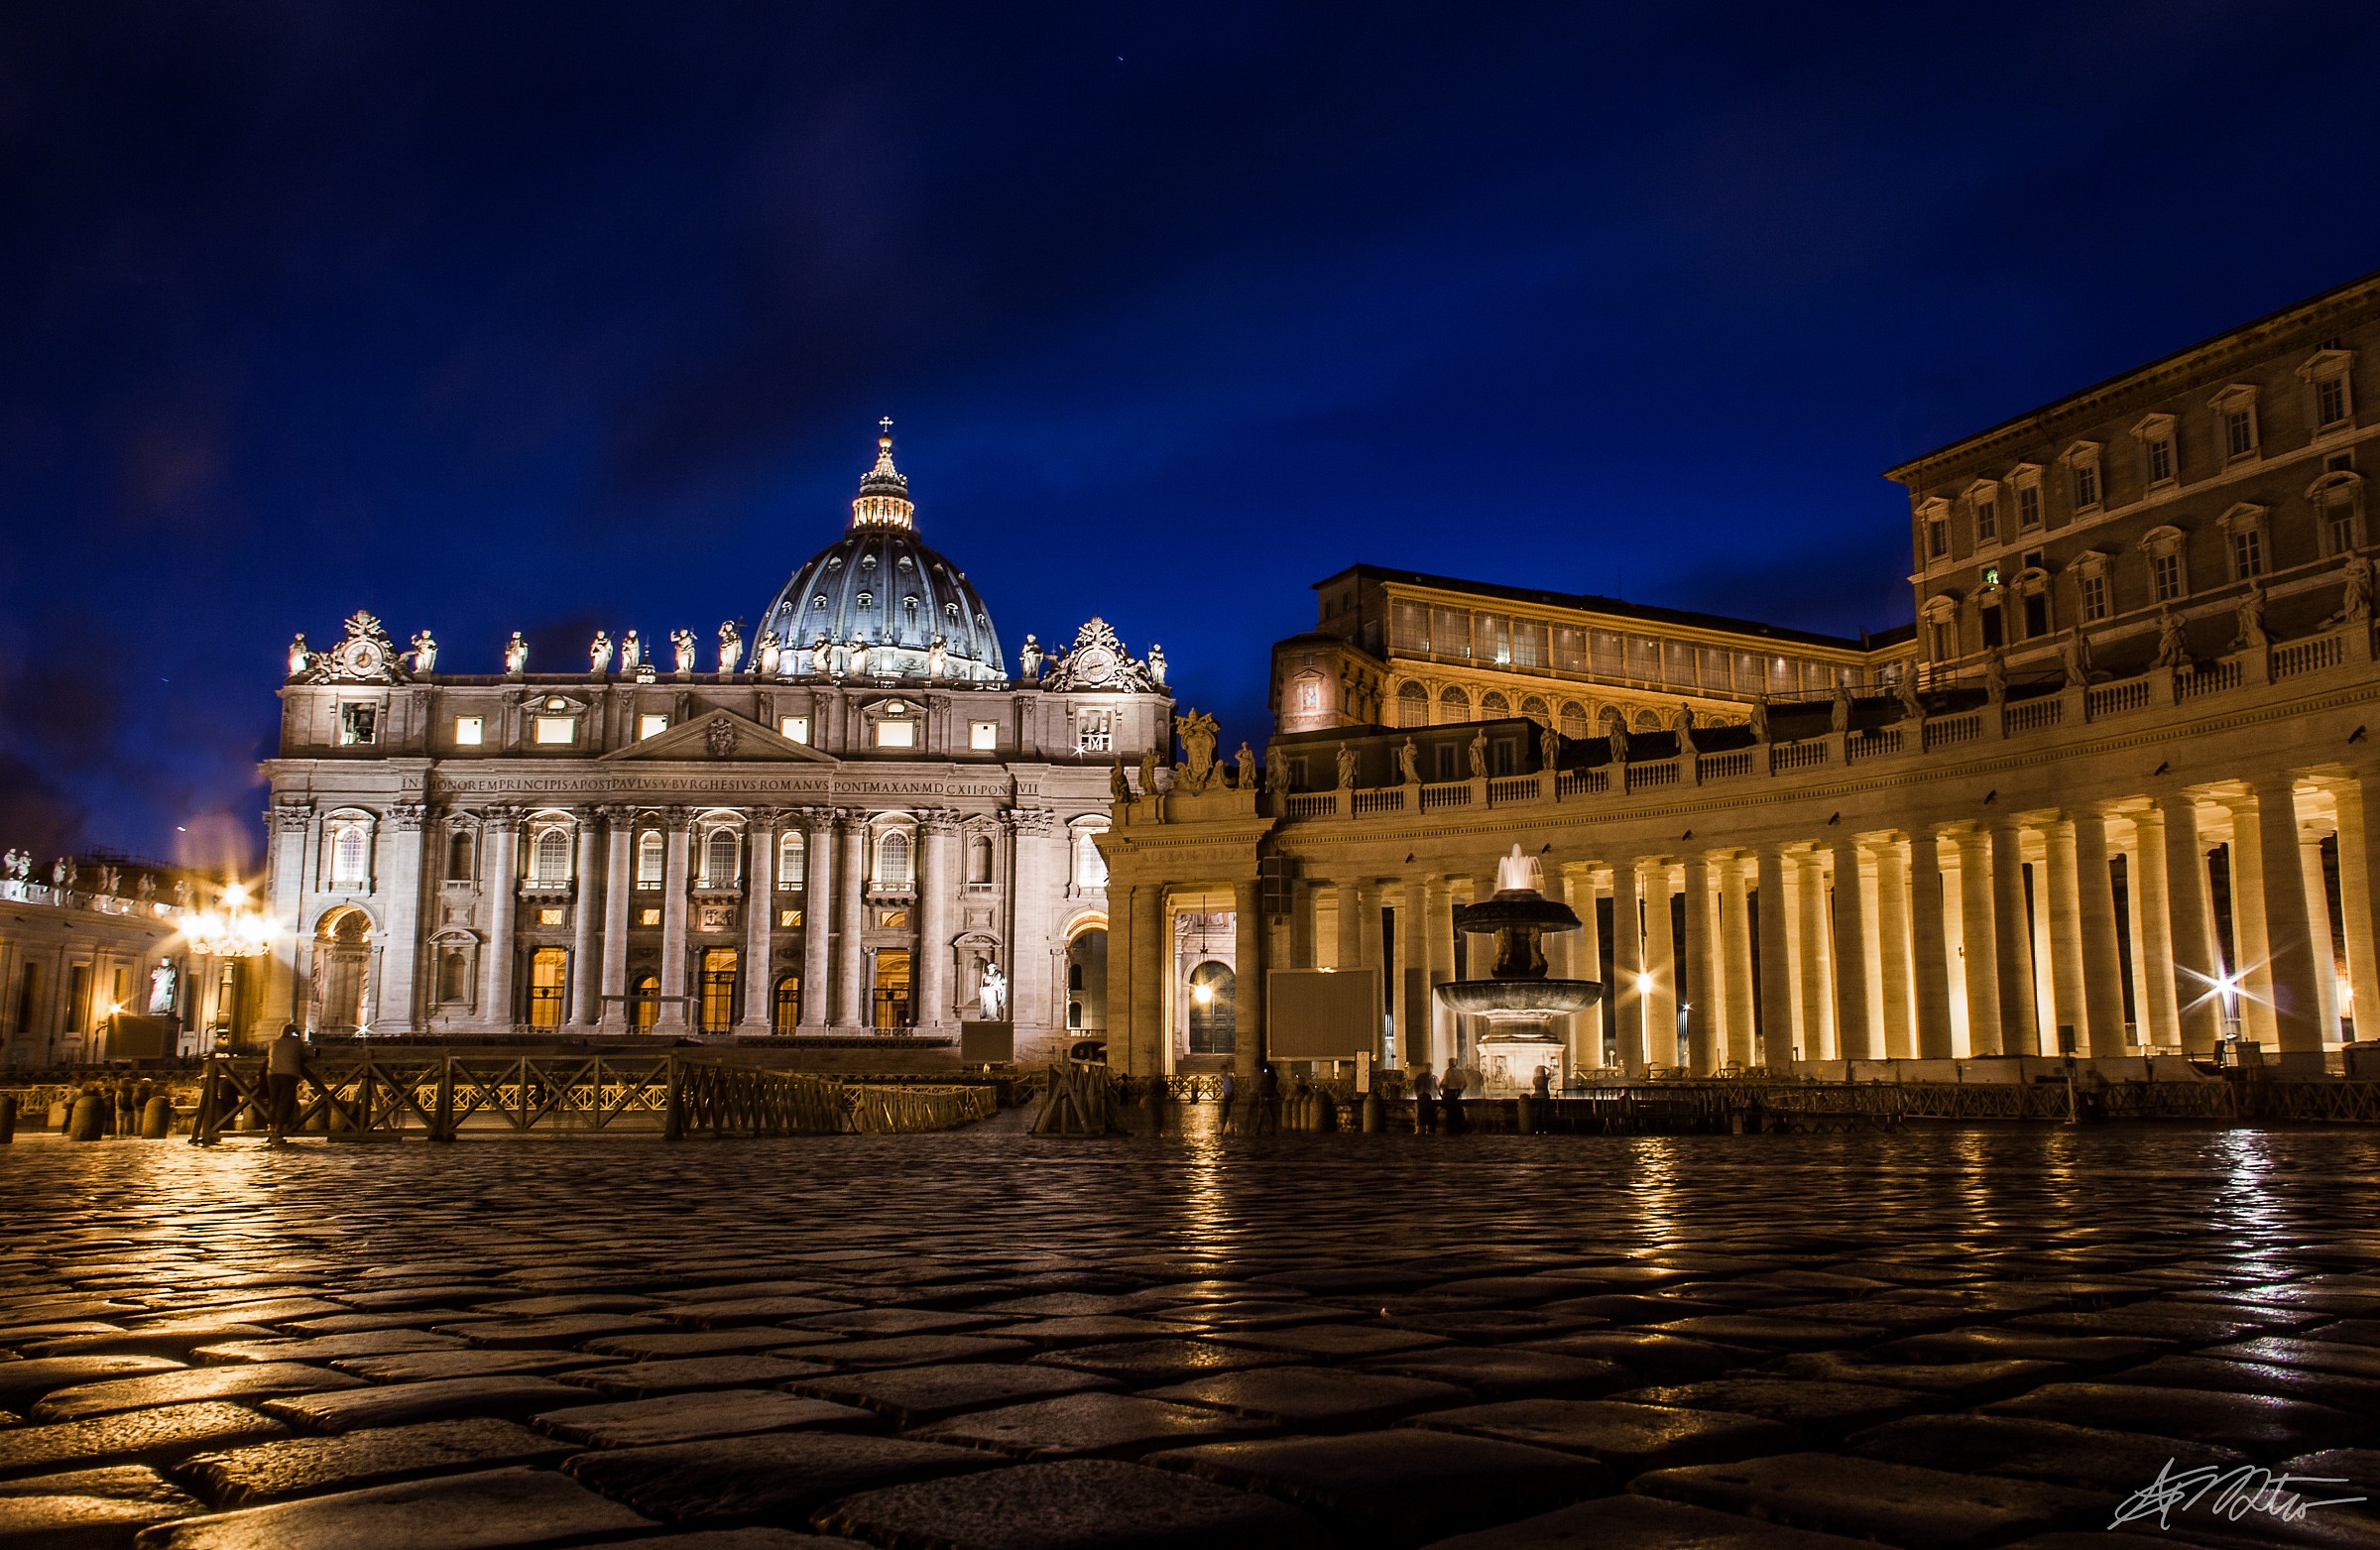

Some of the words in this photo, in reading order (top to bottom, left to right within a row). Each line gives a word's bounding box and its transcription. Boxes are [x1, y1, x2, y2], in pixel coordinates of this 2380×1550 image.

[402, 777, 417, 788] IN
[426, 778, 497, 790] HONOREM
[499, 778, 567, 789] PRINCIPIS
[569, 778, 612, 790] APOST
[612, 778, 657, 789] PAVLVS
[672, 778, 756, 790] BVRGHESIVS
[760, 779, 829, 790] ROMANVS
[834, 781, 870, 792] PONT
[870, 781, 900, 792] MAX
[1019, 783, 1037, 793] VII
